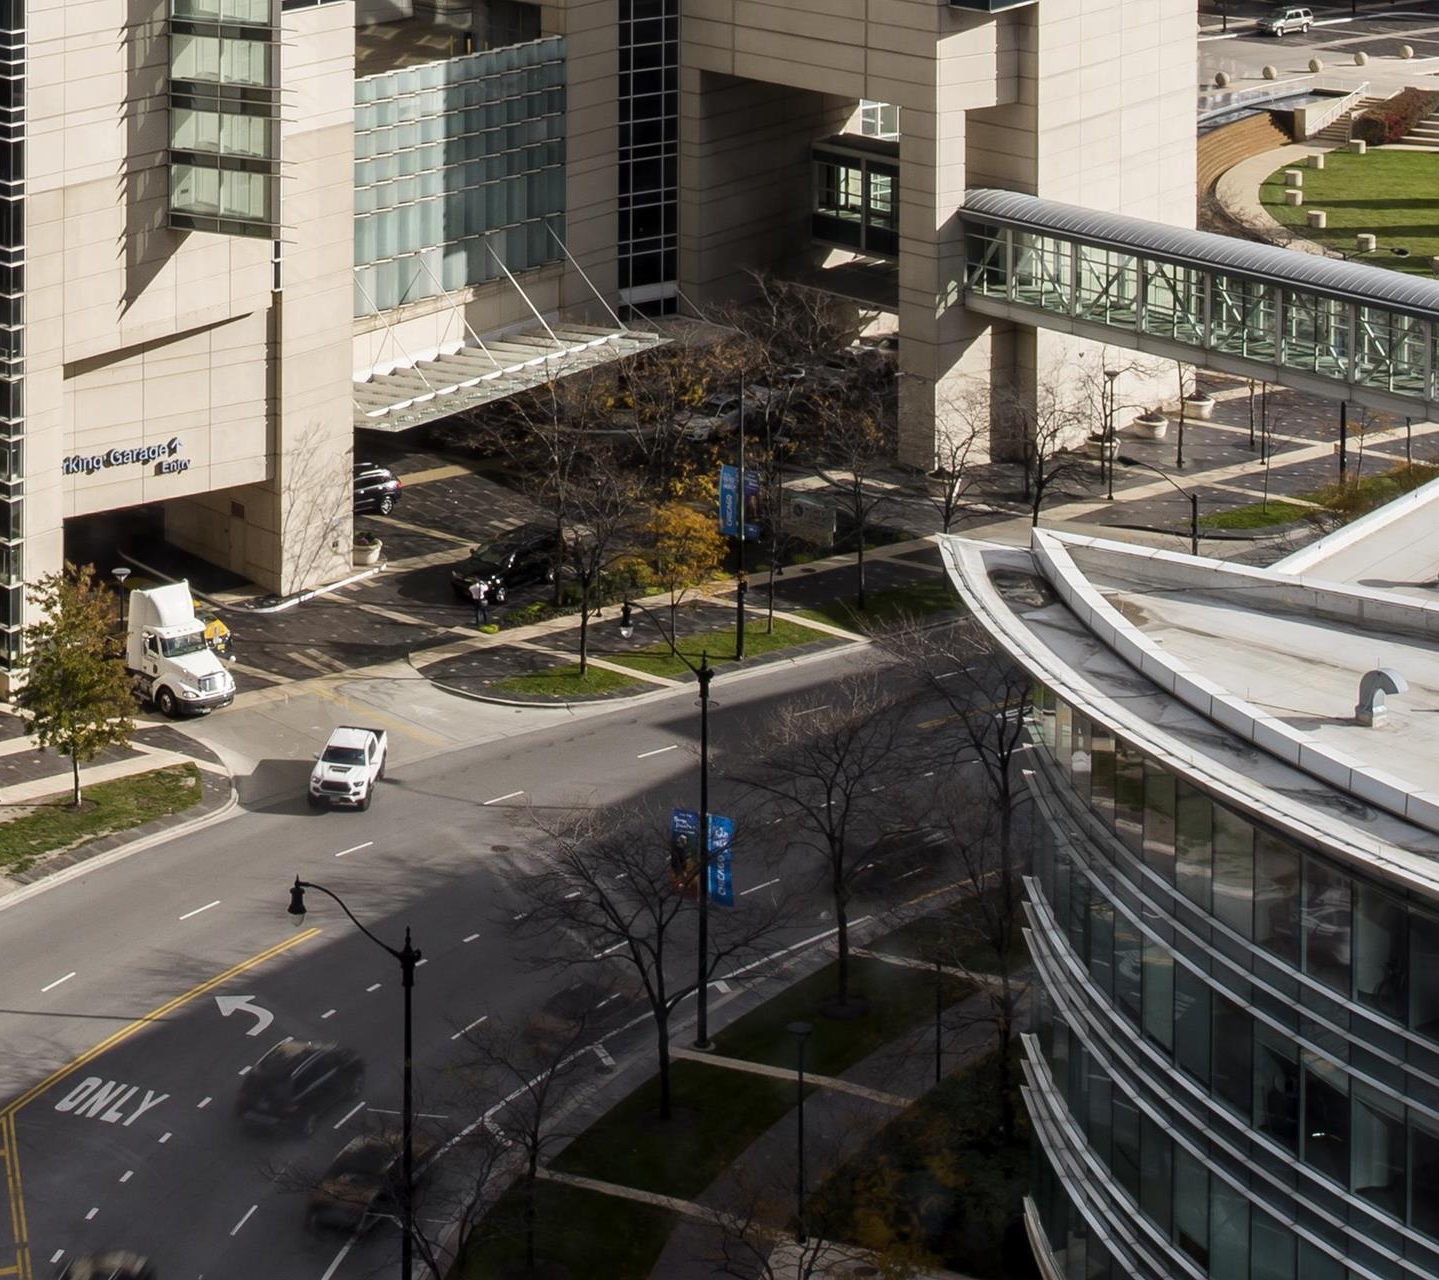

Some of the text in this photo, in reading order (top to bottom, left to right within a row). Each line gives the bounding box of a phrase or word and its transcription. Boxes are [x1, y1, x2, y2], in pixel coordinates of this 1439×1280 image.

[61, 444, 169, 476] rking Garage
[161, 457, 191, 475] Entry
[55, 1076, 171, 1126] ONLY
